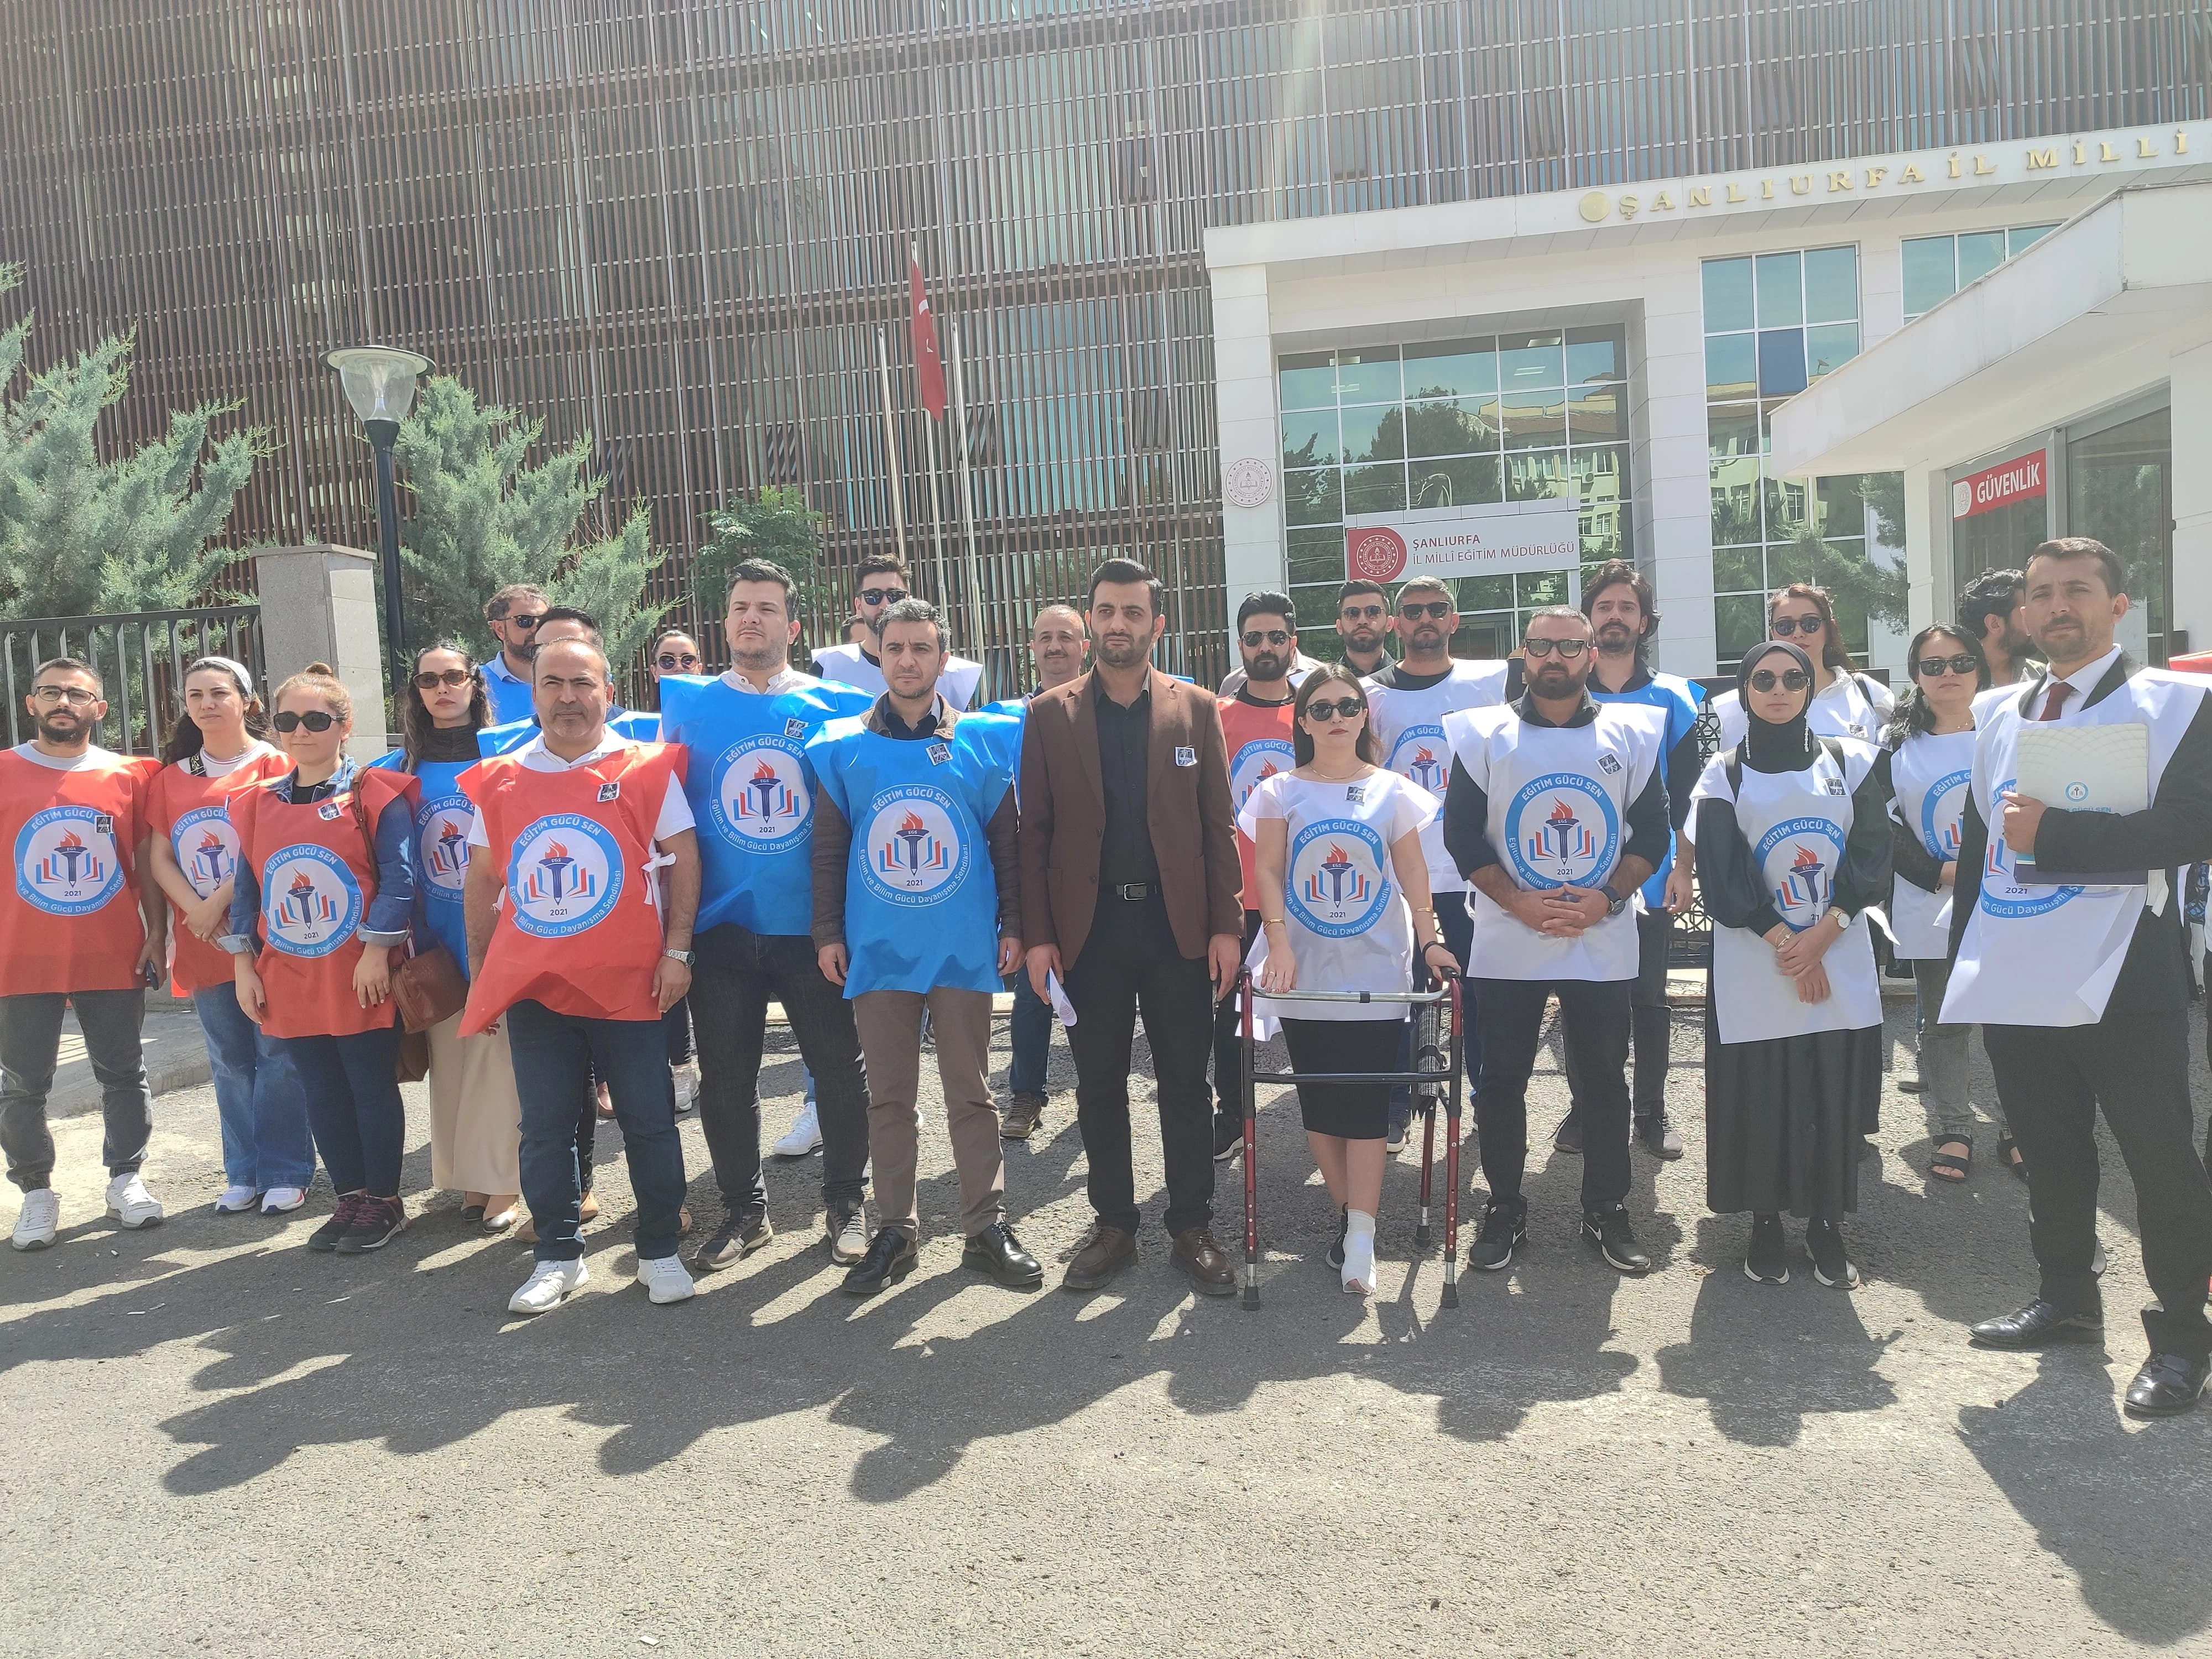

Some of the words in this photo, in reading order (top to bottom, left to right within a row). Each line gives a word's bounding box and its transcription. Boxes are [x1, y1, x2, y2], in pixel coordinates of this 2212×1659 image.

[1619, 163, 1924, 220] ŞANLIURFA
[1948, 151, 1995, 179] İL
[2026, 128, 2188, 170] MİLLİ
[1977, 460, 2041, 503] GÜVENLİK
[1413, 534, 1480, 551] ŞANLIURFA
[1413, 554, 1422, 565] İL
[1425, 551, 1454, 564] MİLLÎ
[1458, 548, 1496, 561] EĞİTİM
[1501, 541, 1574, 558] MÜDÜRLÜĞÜ
[1417, 726, 1439, 734] GÜCÜ
[726, 740, 755, 763] EĞİTİM
[758, 737, 785, 747] GÜCÜ
[786, 745, 804, 759] SEN
[1239, 743, 1262, 761] EĞİTİM
[1264, 741, 1287, 750] GÜCÜ
[872, 789, 903, 812] EĞİTİM
[906, 786, 933, 797] GÜCÜ
[934, 792, 951, 808] SEN
[1521, 778, 1553, 801] EĞİTİM
[1554, 775, 1583, 786] GÜCÜ
[1585, 782, 1603, 798] SEN
[1933, 775, 1962, 797] EĞİTİM
[32, 811, 62, 830] EĞİTİM
[65, 808, 93, 818] GÜCÜ
[175, 813, 199, 836] EĞİTİM
[201, 808, 223, 818] GÜCÜ
[419, 803, 441, 827] EĞİTİM
[444, 798, 467, 807] GÜCÜ
[519, 820, 547, 847] EĞİTİM
[551, 816, 580, 826] GÜCÜ
[581, 821, 601, 836] SEN
[722, 824, 728, 833] ve
[728, 830, 746, 846] Bilim
[747, 841, 767, 851] Gücü
[770, 828, 807, 851] Dayanışma
[1299, 823, 1329, 844] EĞİTİM
[1332, 821, 1360, 832] GÜCÜ
[1361, 828, 1379, 845] SEN
[1762, 825, 1791, 851] EĞİTİM
[1793, 820, 1823, 830] GÜCÜ
[1825, 824, 1840, 839] SEN
[267, 851, 291, 875] EĞİTİM
[293, 847, 316, 856] GÜCÜ
[318, 851, 338, 865] SEN
[859, 849, 868, 876] Eğitim
[867, 875, 874, 885] ve
[873, 883, 893, 899] Bilim
[895, 893, 915, 903] Gücü
[918, 881, 957, 903] Dayanışma
[955, 844, 968, 881] Sendikası
[1509, 837, 1519, 863] Eğitim
[1525, 871, 1543, 888] Bilim
[1600, 833, 1616, 869] Sendikası
[20, 886, 29, 895] ve
[28, 893, 48, 909] Bilim
[50, 904, 72, 912] Gücü
[75, 892, 111, 912] Dayanışma
[109, 871, 124, 891] Sendi
[536, 925, 557, 934] Gücü
[561, 909, 605, 933] Dayanışma
[603, 870, 621, 909] Sendikası
[1991, 904, 2013, 915] Gücü
[2017, 890, 2070, 914] Dayanışma
[275, 939, 294, 952] Bilim
[346, 895, 360, 930] Sendikası
[1291, 904, 1299, 912] ve
[1298, 911, 1315, 928] Bilim
[1317, 925, 1338, 936] Gücü
[1340, 912, 1378, 936] Dayanışma
